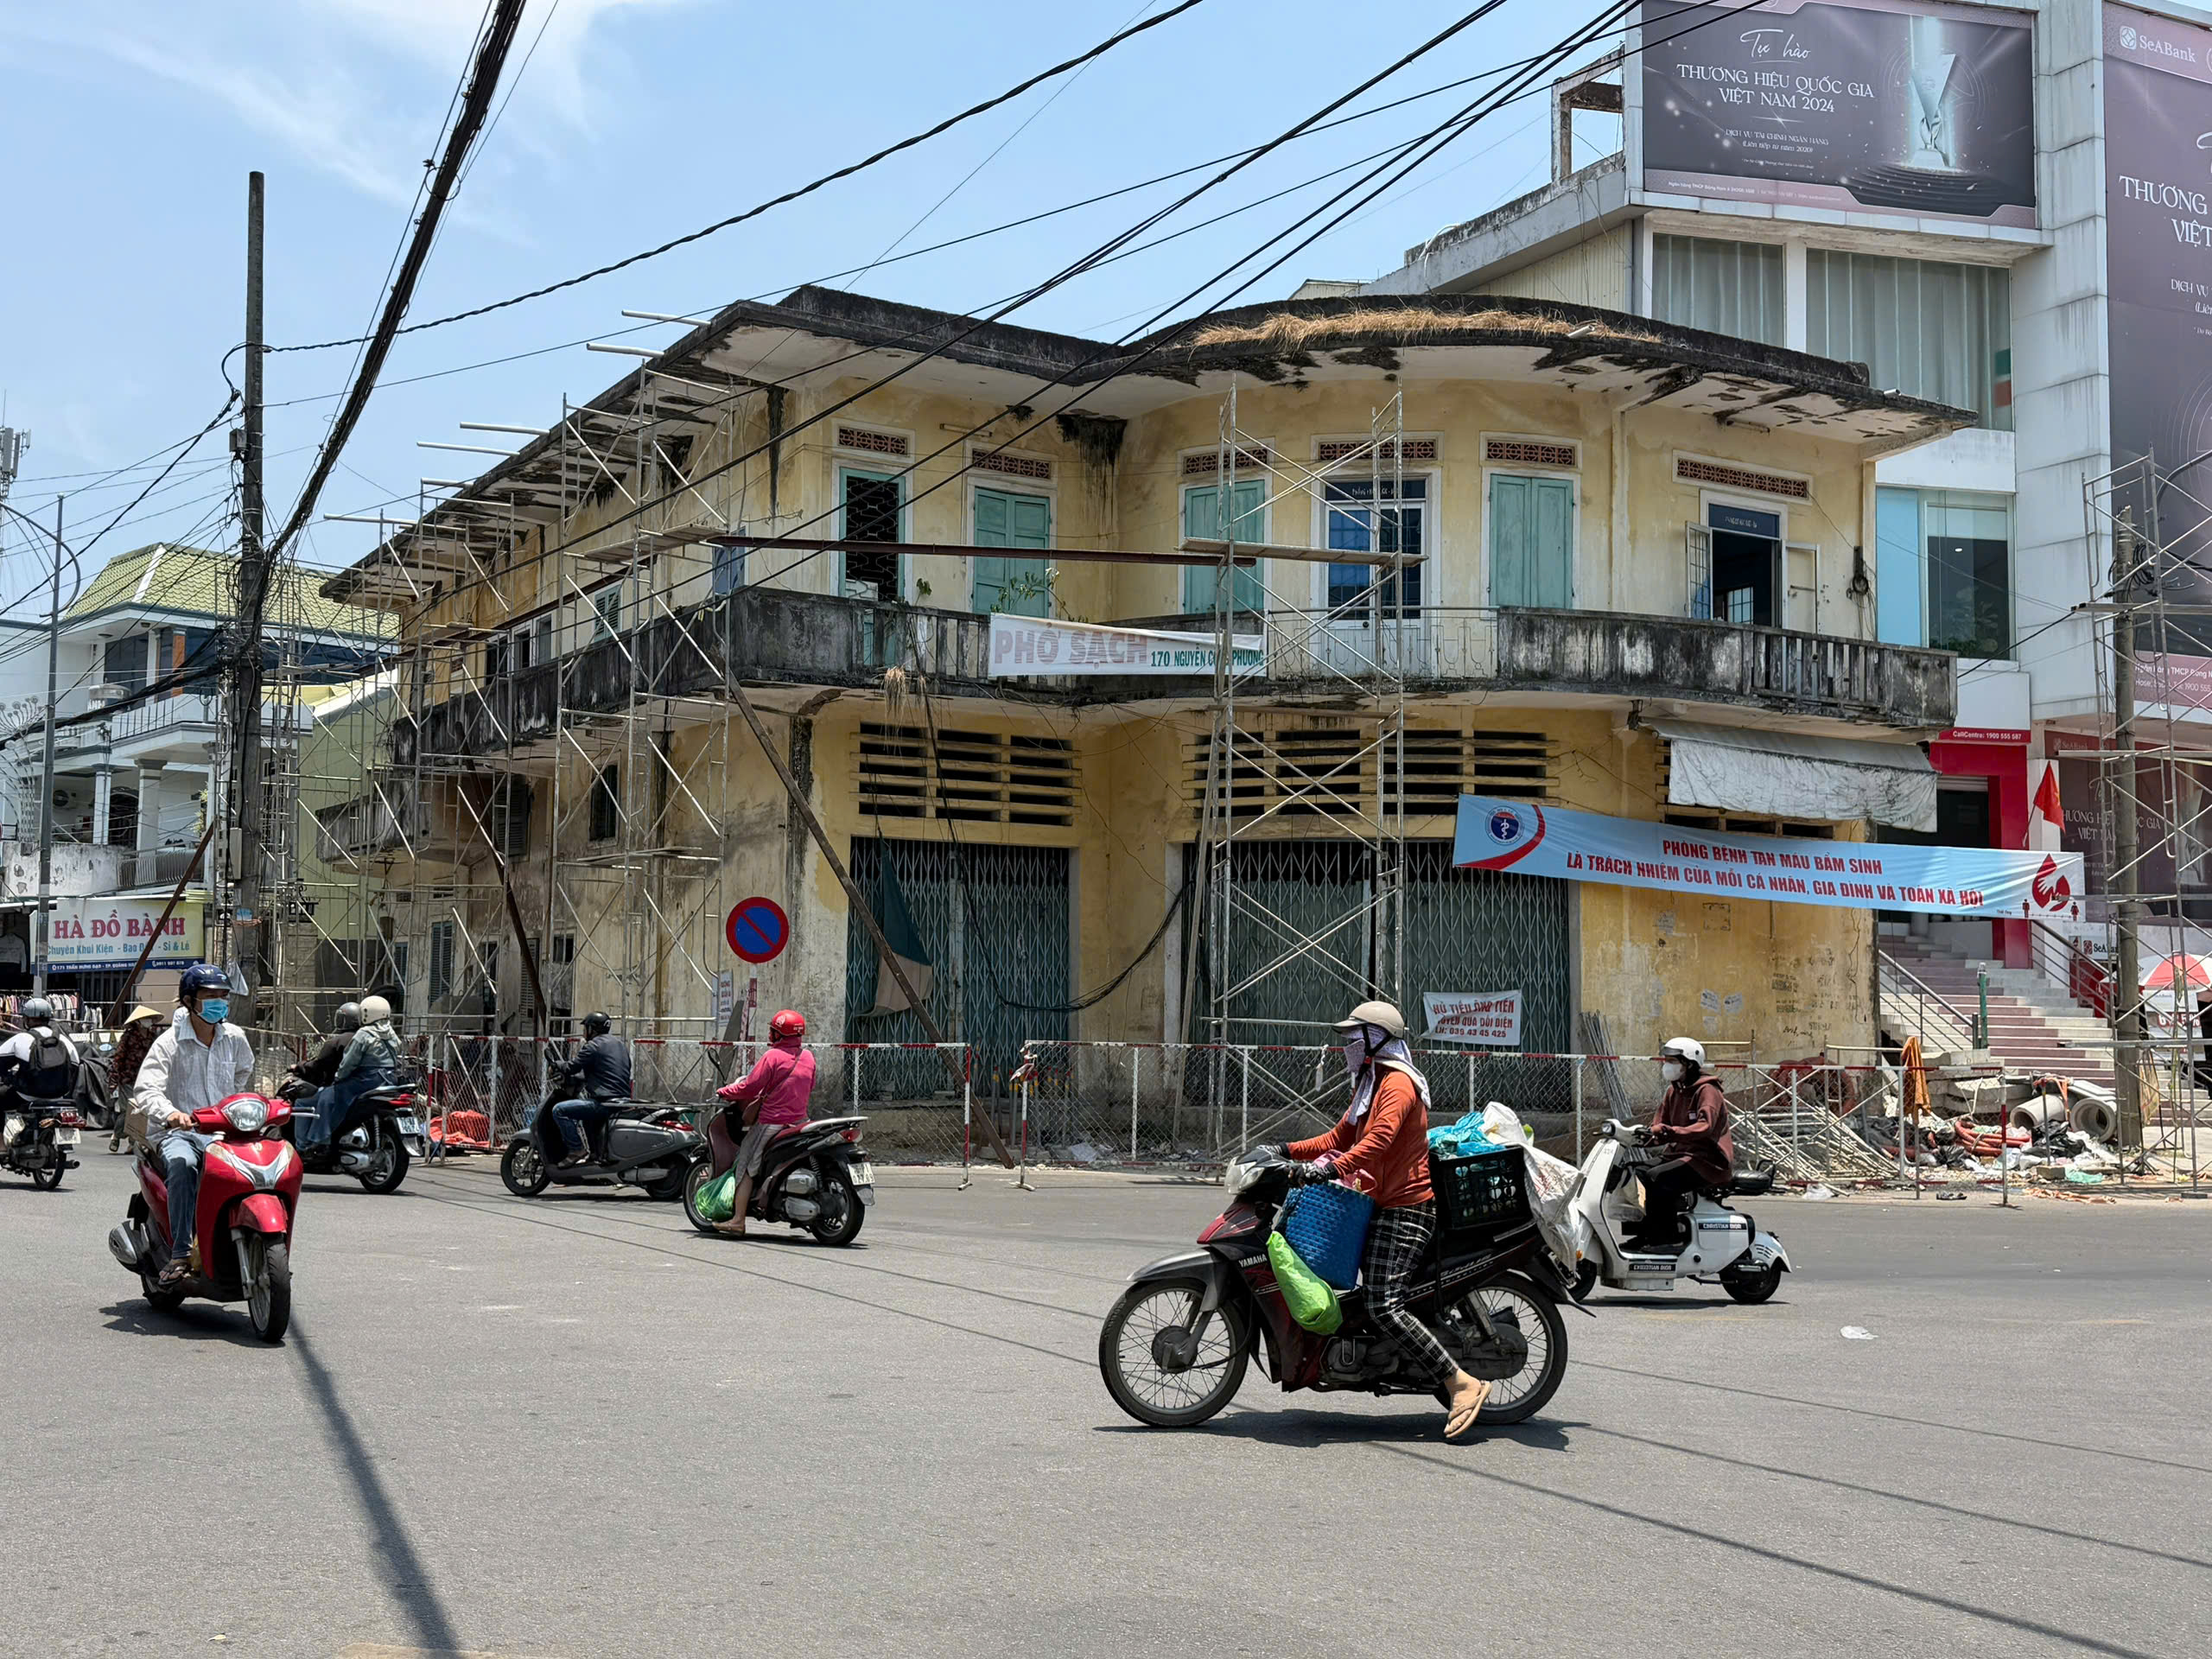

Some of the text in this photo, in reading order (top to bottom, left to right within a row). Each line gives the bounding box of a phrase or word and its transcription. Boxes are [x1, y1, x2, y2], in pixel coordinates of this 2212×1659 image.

[1783, 34, 1811, 59] hào
[2139, 35, 2196, 62] SeABank
[1676, 64, 1875, 98] THƯƠNG HIỆU QUỐC GIA
[1719, 87, 1835, 112] VIỆT NAM 2024
[2119, 175, 2208, 215] THƯƠNG
[994, 621, 1148, 670] PHỞ SẠCH
[1151, 651, 1170, 667] 170
[1174, 643, 1205, 667] NGUYỄN
[2171, 666, 2190, 675] TMCP
[2063, 809, 2094, 823] HƯƠNG
[1662, 836, 1708, 860] PHÒNG
[1712, 843, 1747, 865] BỆNH
[1749, 849, 1776, 867] TAN
[1779, 851, 1811, 870] MÁU
[1849, 857, 1883, 875] SINH
[1567, 849, 1985, 907] LÀ TRÁCH NHIỆM CỦA MỖI CÁ NHÂN, GIA ĐÌNH VÀ TOÀN XÃ HỘI
[54, 909, 186, 939] HÀ ĐỒ BÀNH
[76, 944, 94, 955] Khui
[123, 943, 137, 953] Bao
[1433, 1001, 1447, 1014] HỦ
[1238, 1253, 1268, 1268] YAMAHA
